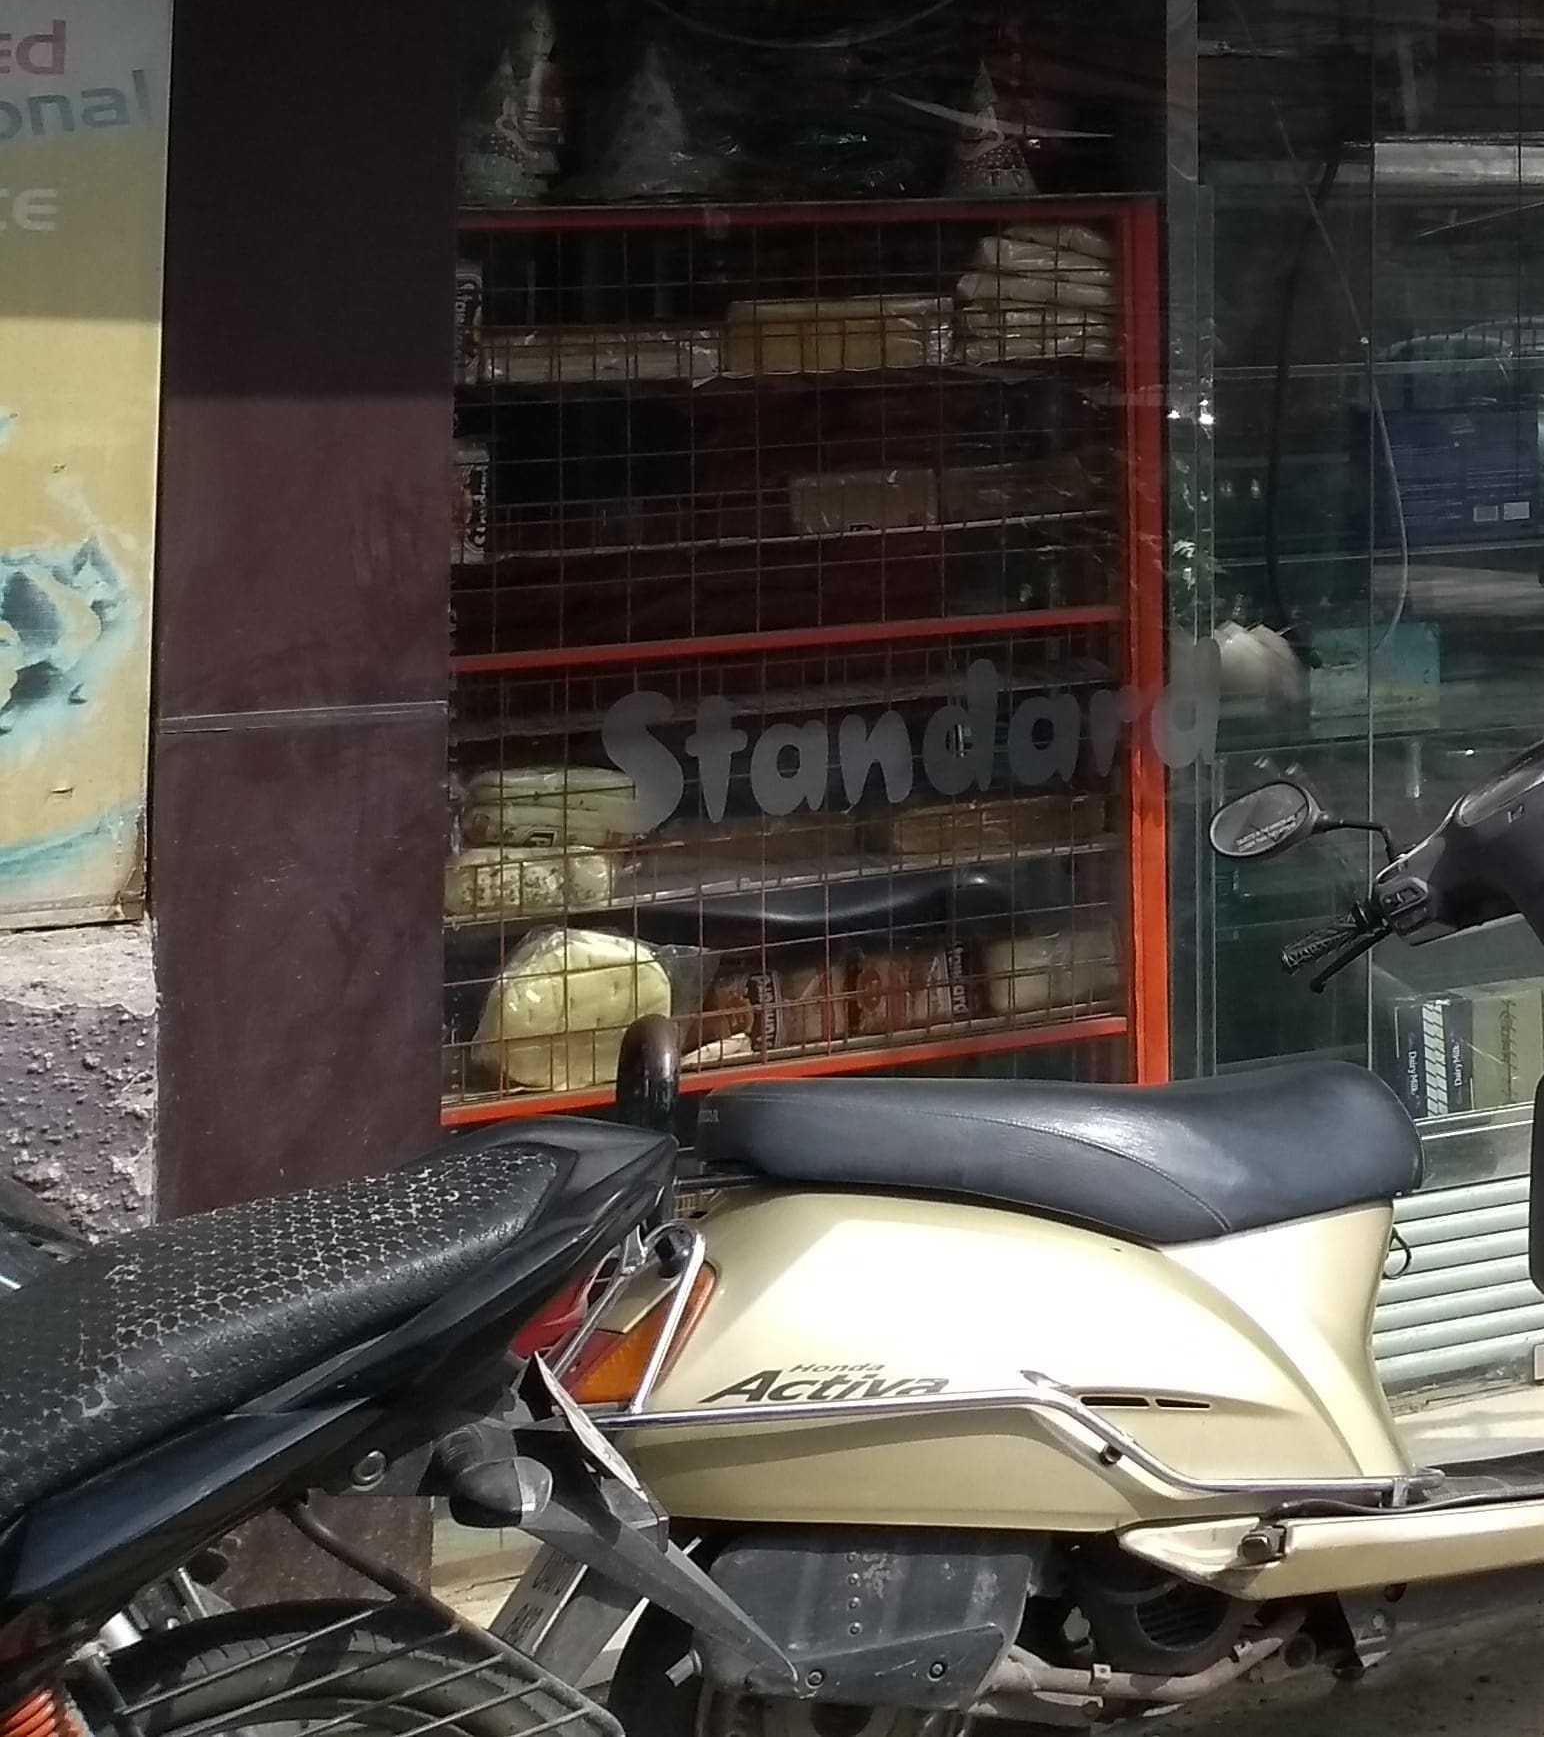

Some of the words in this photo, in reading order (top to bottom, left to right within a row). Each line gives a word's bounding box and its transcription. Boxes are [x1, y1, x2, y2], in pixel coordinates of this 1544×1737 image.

[601, 637, 1221, 833] Standard
[1407, 1050, 1419, 1077] Dairy
[1454, 1064, 1463, 1087] Dairy
[788, 1362, 886, 1375] Honda
[697, 1370, 950, 1404] Activa
